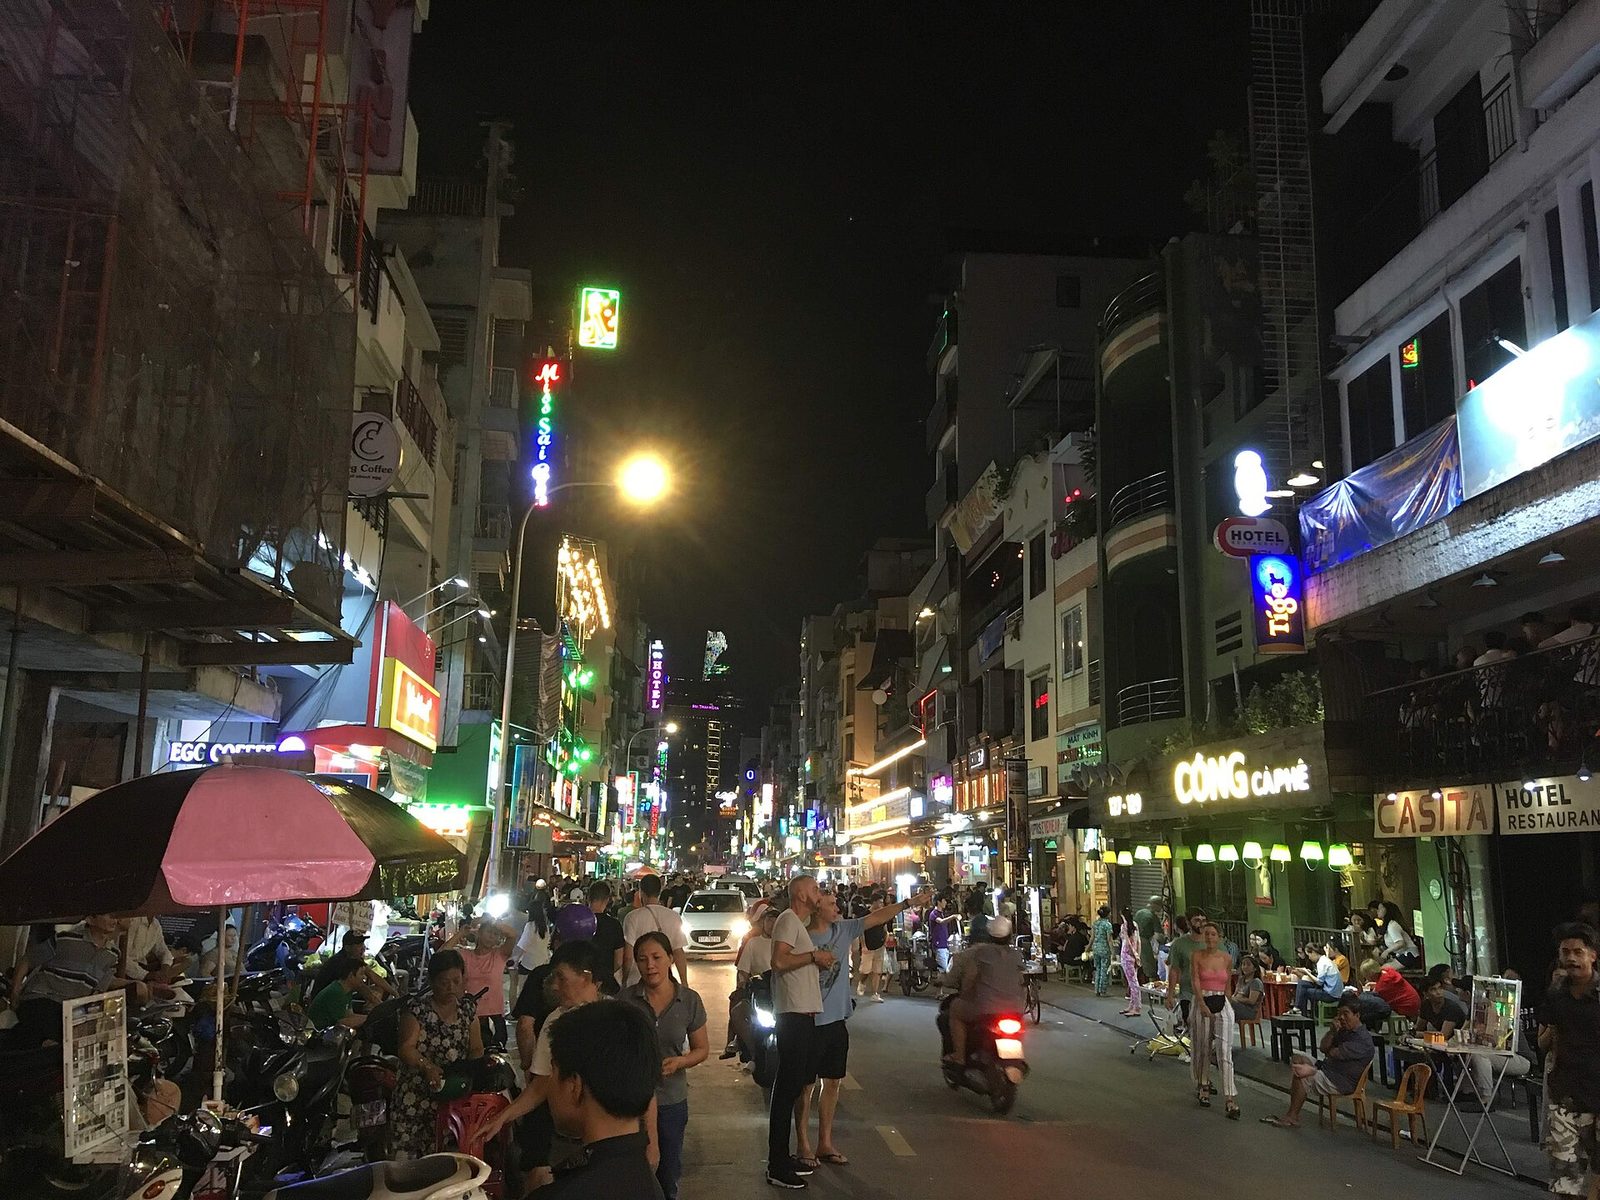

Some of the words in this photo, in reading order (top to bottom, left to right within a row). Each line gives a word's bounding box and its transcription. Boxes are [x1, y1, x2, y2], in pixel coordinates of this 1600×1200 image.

[360, 463, 394, 474] Coffee
[1230, 529, 1285, 543] HOTEL
[1264, 572, 1298, 637] Tiger
[651, 660, 663, 709] HOTEL
[168, 742, 207, 763] EGG
[1504, 783, 1573, 810] HOTEL
[1377, 791, 1489, 834] CASITA
[1507, 809, 1600, 830] RESTAURAN
